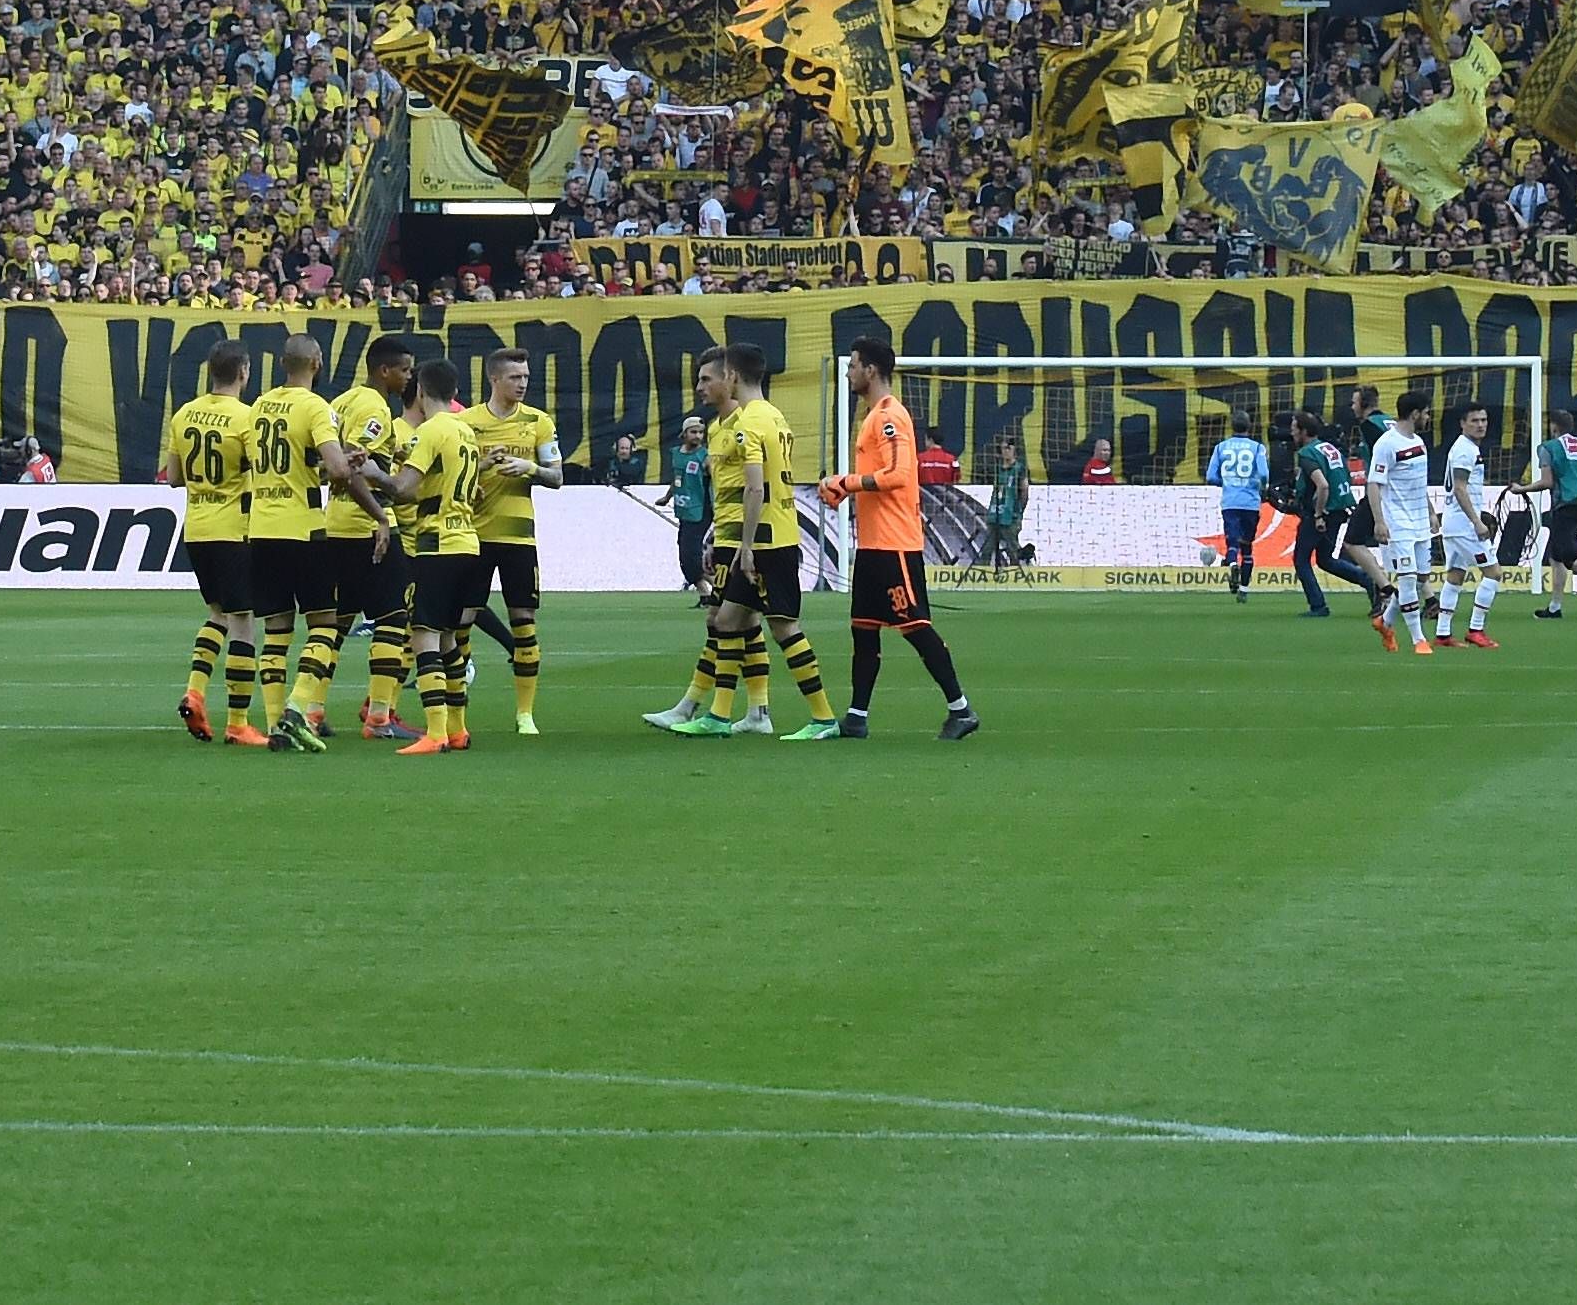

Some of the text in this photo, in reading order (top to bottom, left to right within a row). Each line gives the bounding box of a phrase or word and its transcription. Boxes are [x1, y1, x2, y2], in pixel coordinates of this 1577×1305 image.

[184, 409, 232, 429] PISZCZEK
[183, 426, 225, 486] 26
[254, 417, 292, 476] 36
[1220, 449, 1255, 479] 28
[933, 569, 1062, 585] IDUNA PARK
[1104, 571, 1168, 585] SIGNAL
[887, 586, 909, 613] 38
